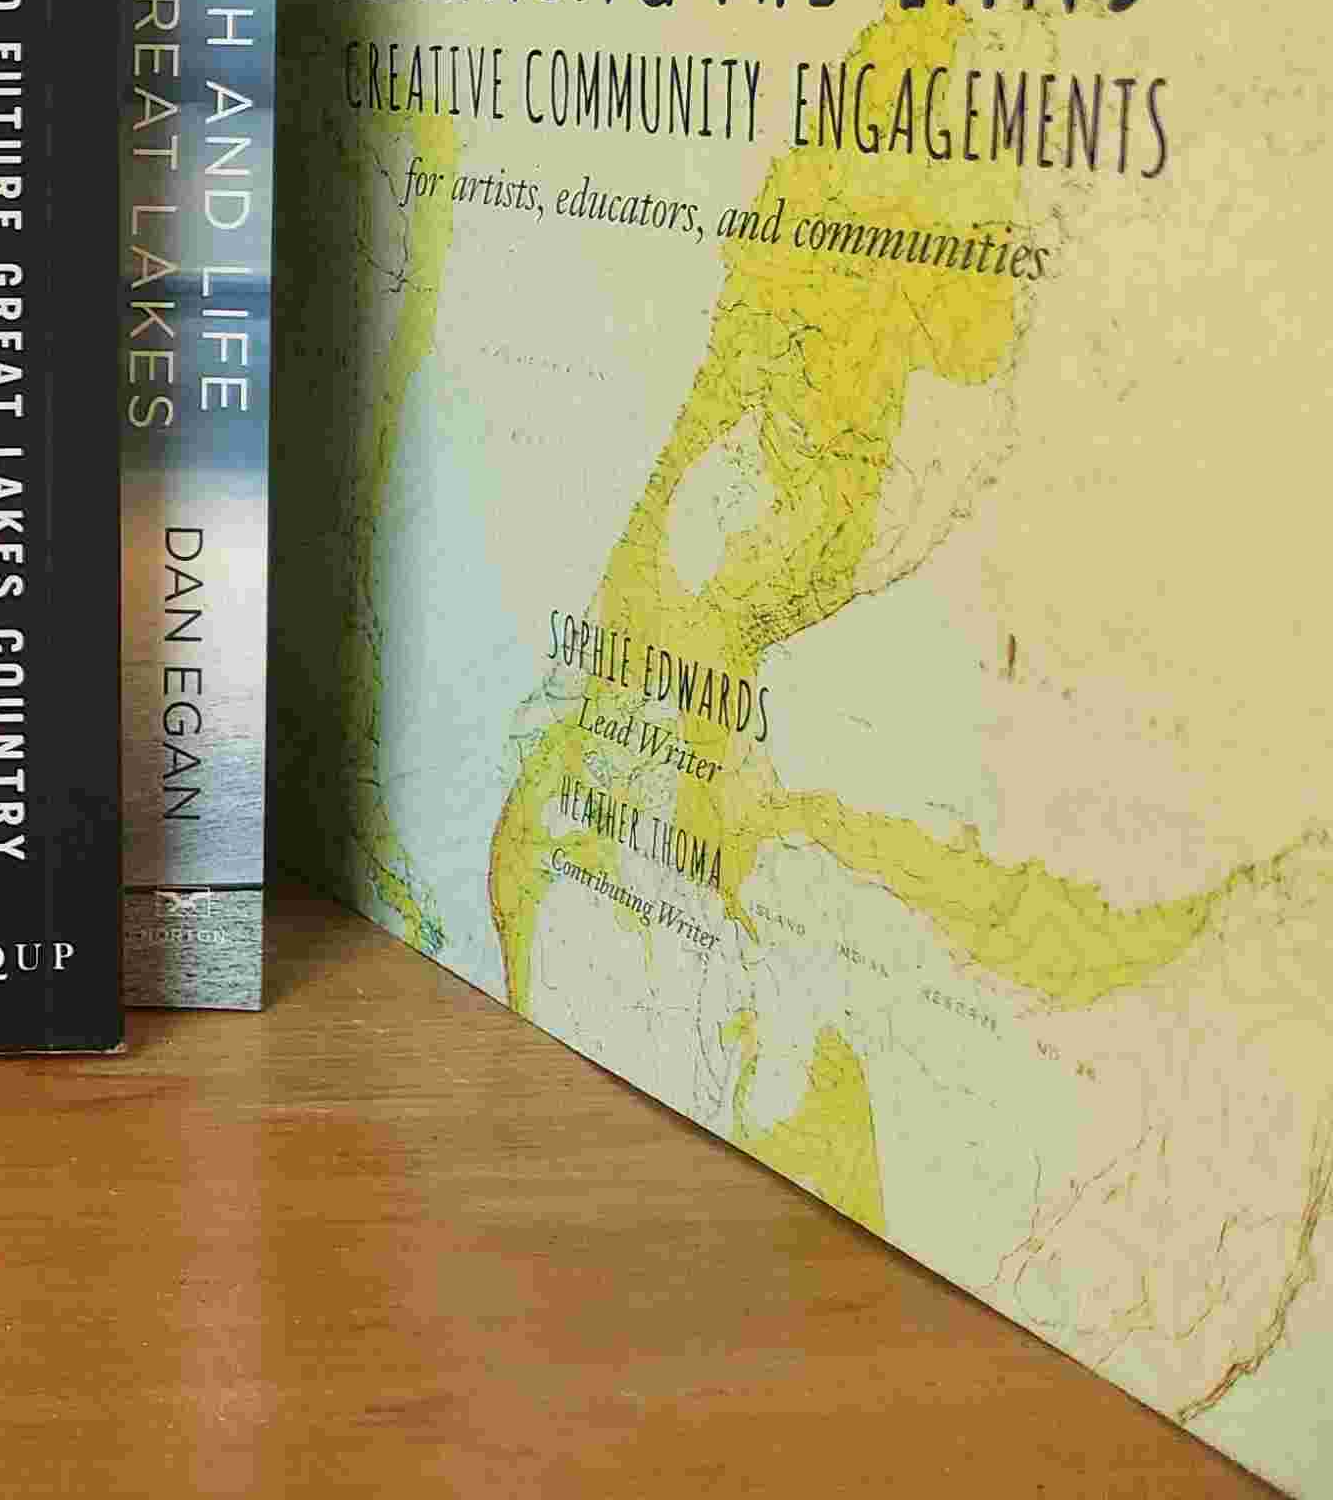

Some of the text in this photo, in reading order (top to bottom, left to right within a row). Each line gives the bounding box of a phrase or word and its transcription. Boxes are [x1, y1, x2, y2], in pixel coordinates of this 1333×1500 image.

[204, 82, 251, 230] AND
[345, 40, 1169, 178] CREATIVE COMMUNITY ENGAGEMENTS
[399, 158, 1049, 280] for artists, educators, and communities
[128, 205, 177, 430] LAKES
[200, 267, 249, 413] LIFE
[163, 529, 204, 822] DAN EGAN
[549, 610, 769, 741] SOPHIE EDWARDS
[578, 698, 722, 783] Lead Writer
[551, 848, 719, 950] Contributing Writer
[560, 775, 722, 890] HEATHER THOMA
